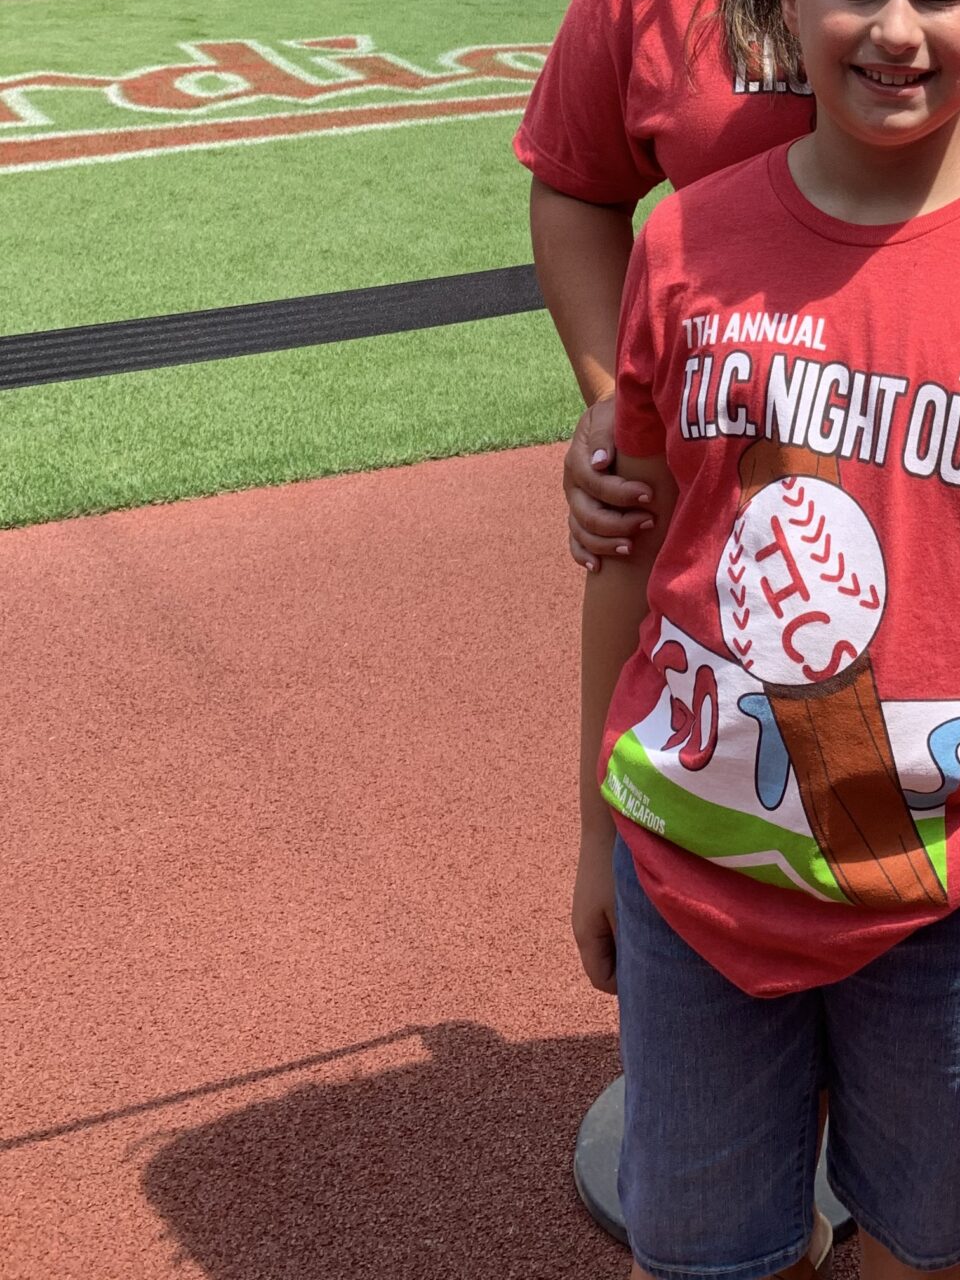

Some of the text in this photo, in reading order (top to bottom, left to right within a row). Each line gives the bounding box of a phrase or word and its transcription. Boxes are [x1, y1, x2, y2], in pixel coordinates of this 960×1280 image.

[683, 312, 827, 351] 7TH ANNUAL
[680, 350, 756, 440] T.I.C.
[765, 354, 909, 466] NIGHT
